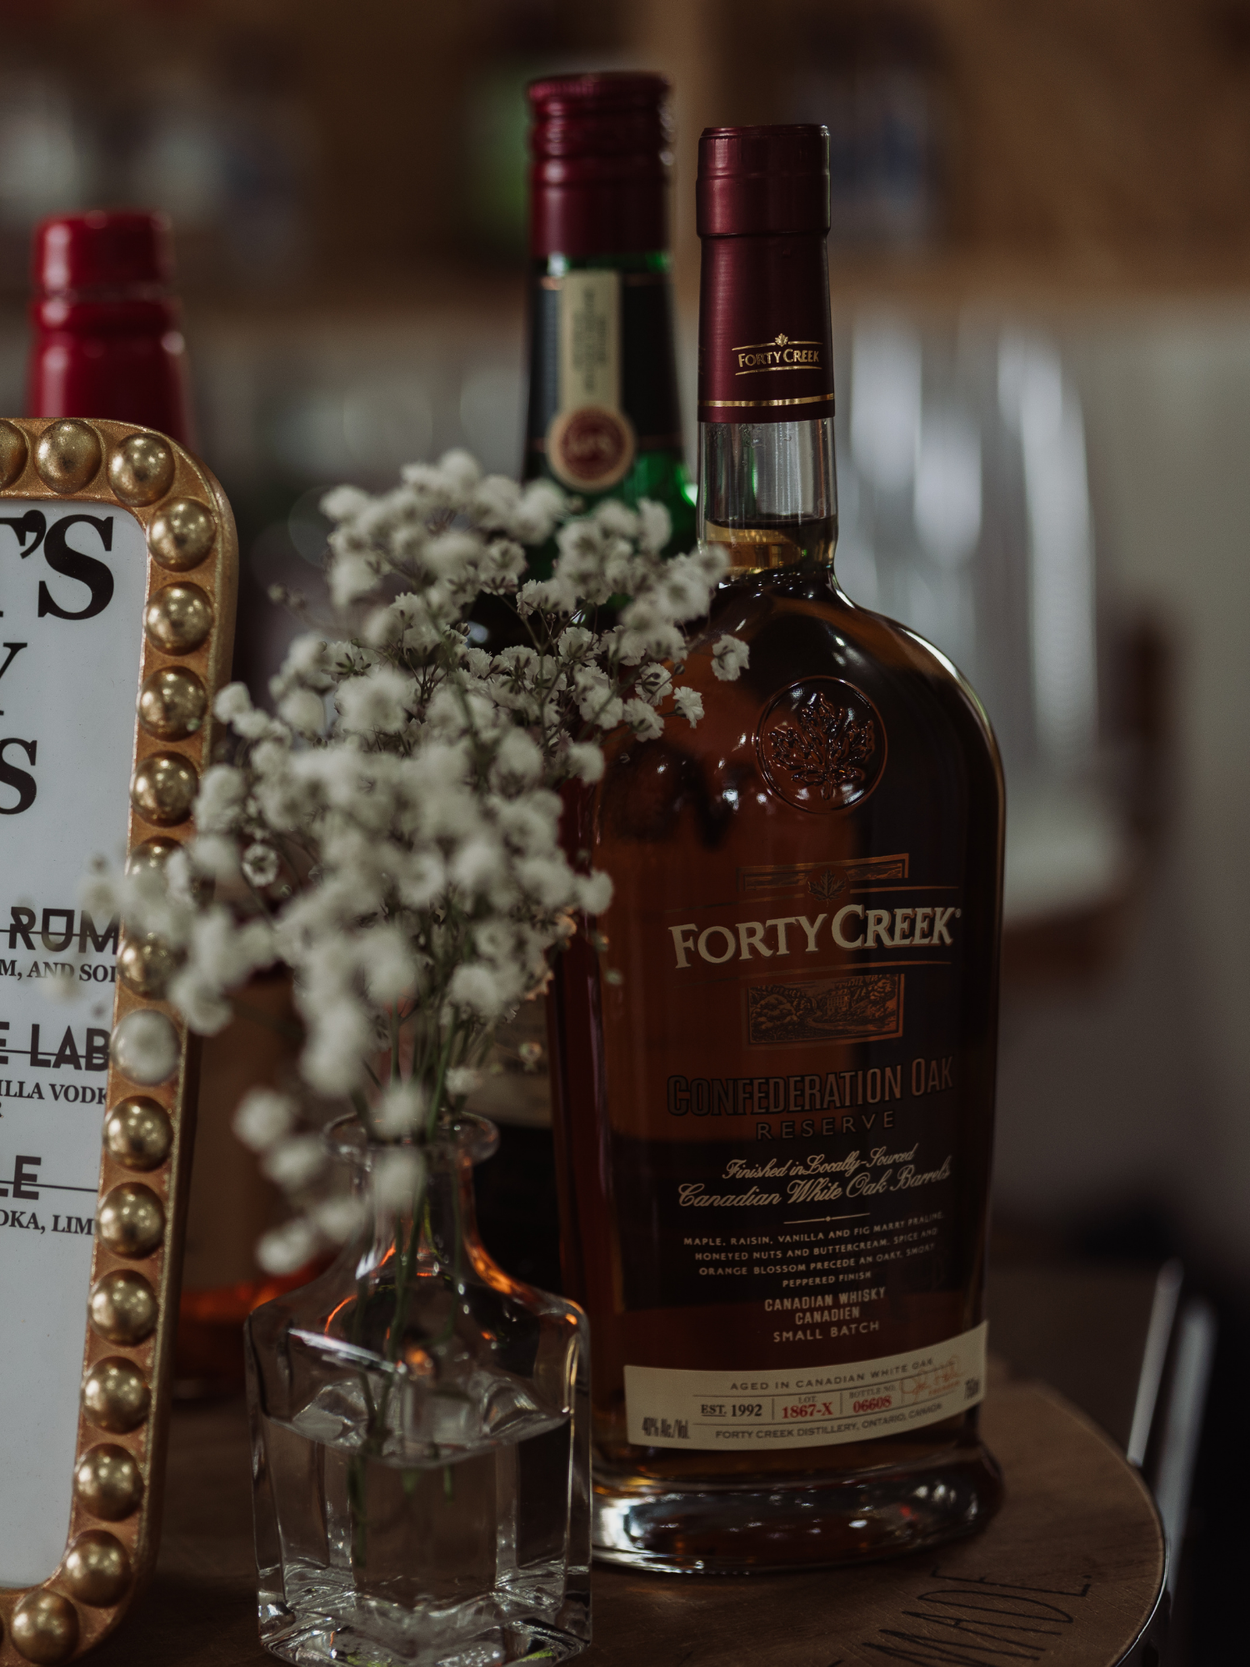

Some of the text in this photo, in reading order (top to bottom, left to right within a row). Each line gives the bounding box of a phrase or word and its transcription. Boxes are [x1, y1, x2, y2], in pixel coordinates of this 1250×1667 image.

[738, 348, 820, 368] FORTY CREEK
[8, 906, 120, 956] RUM
[668, 913, 828, 970] FORTY
[26, 960, 75, 980] AND
[30, 1023, 111, 1072] LAB
[666, 1055, 955, 1117] CONFEDERATION OAK
[756, 1110, 895, 1141] RESERVE
[721, 1142, 919, 1180] Finished in Locally-Sourced
[677, 1154, 953, 1208] Canadian White Oak Barrels
[778, 1232, 825, 1243] VANILLA
[828, 1229, 851, 1240] AND
[853, 1226, 871, 1236] FIG
[872, 1220, 905, 1233] MARRY
[695, 1252, 749, 1261] HONEYED
[753, 1250, 782, 1260] NUTS
[786, 1247, 810, 1258] AND
[893, 1231, 919, 1245] SPICE
[920, 1227, 939, 1238] AND
[698, 1266, 748, 1276] ORANGE
[753, 1263, 806, 1275] BLOSSOM
[809, 1257, 856, 1271] PRECEDE
[859, 1255, 874, 1265] AN
[782, 1270, 872, 1288] PEPPERED FINISH
[764, 1286, 886, 1312] CANADIAN WHISKY
[795, 1306, 860, 1326] CANADIEN
[773, 1320, 880, 1343] SMALL BATCH
[730, 1357, 934, 1391] AGED IN CANADIAN WHITE OAK
[701, 1404, 763, 1417] EST. 1992
[782, 1402, 833, 1419] 1867-X
[853, 1395, 892, 1413] 06608
[716, 1430, 751, 1439] FORTY
[755, 1429, 794, 1438] CREEK
